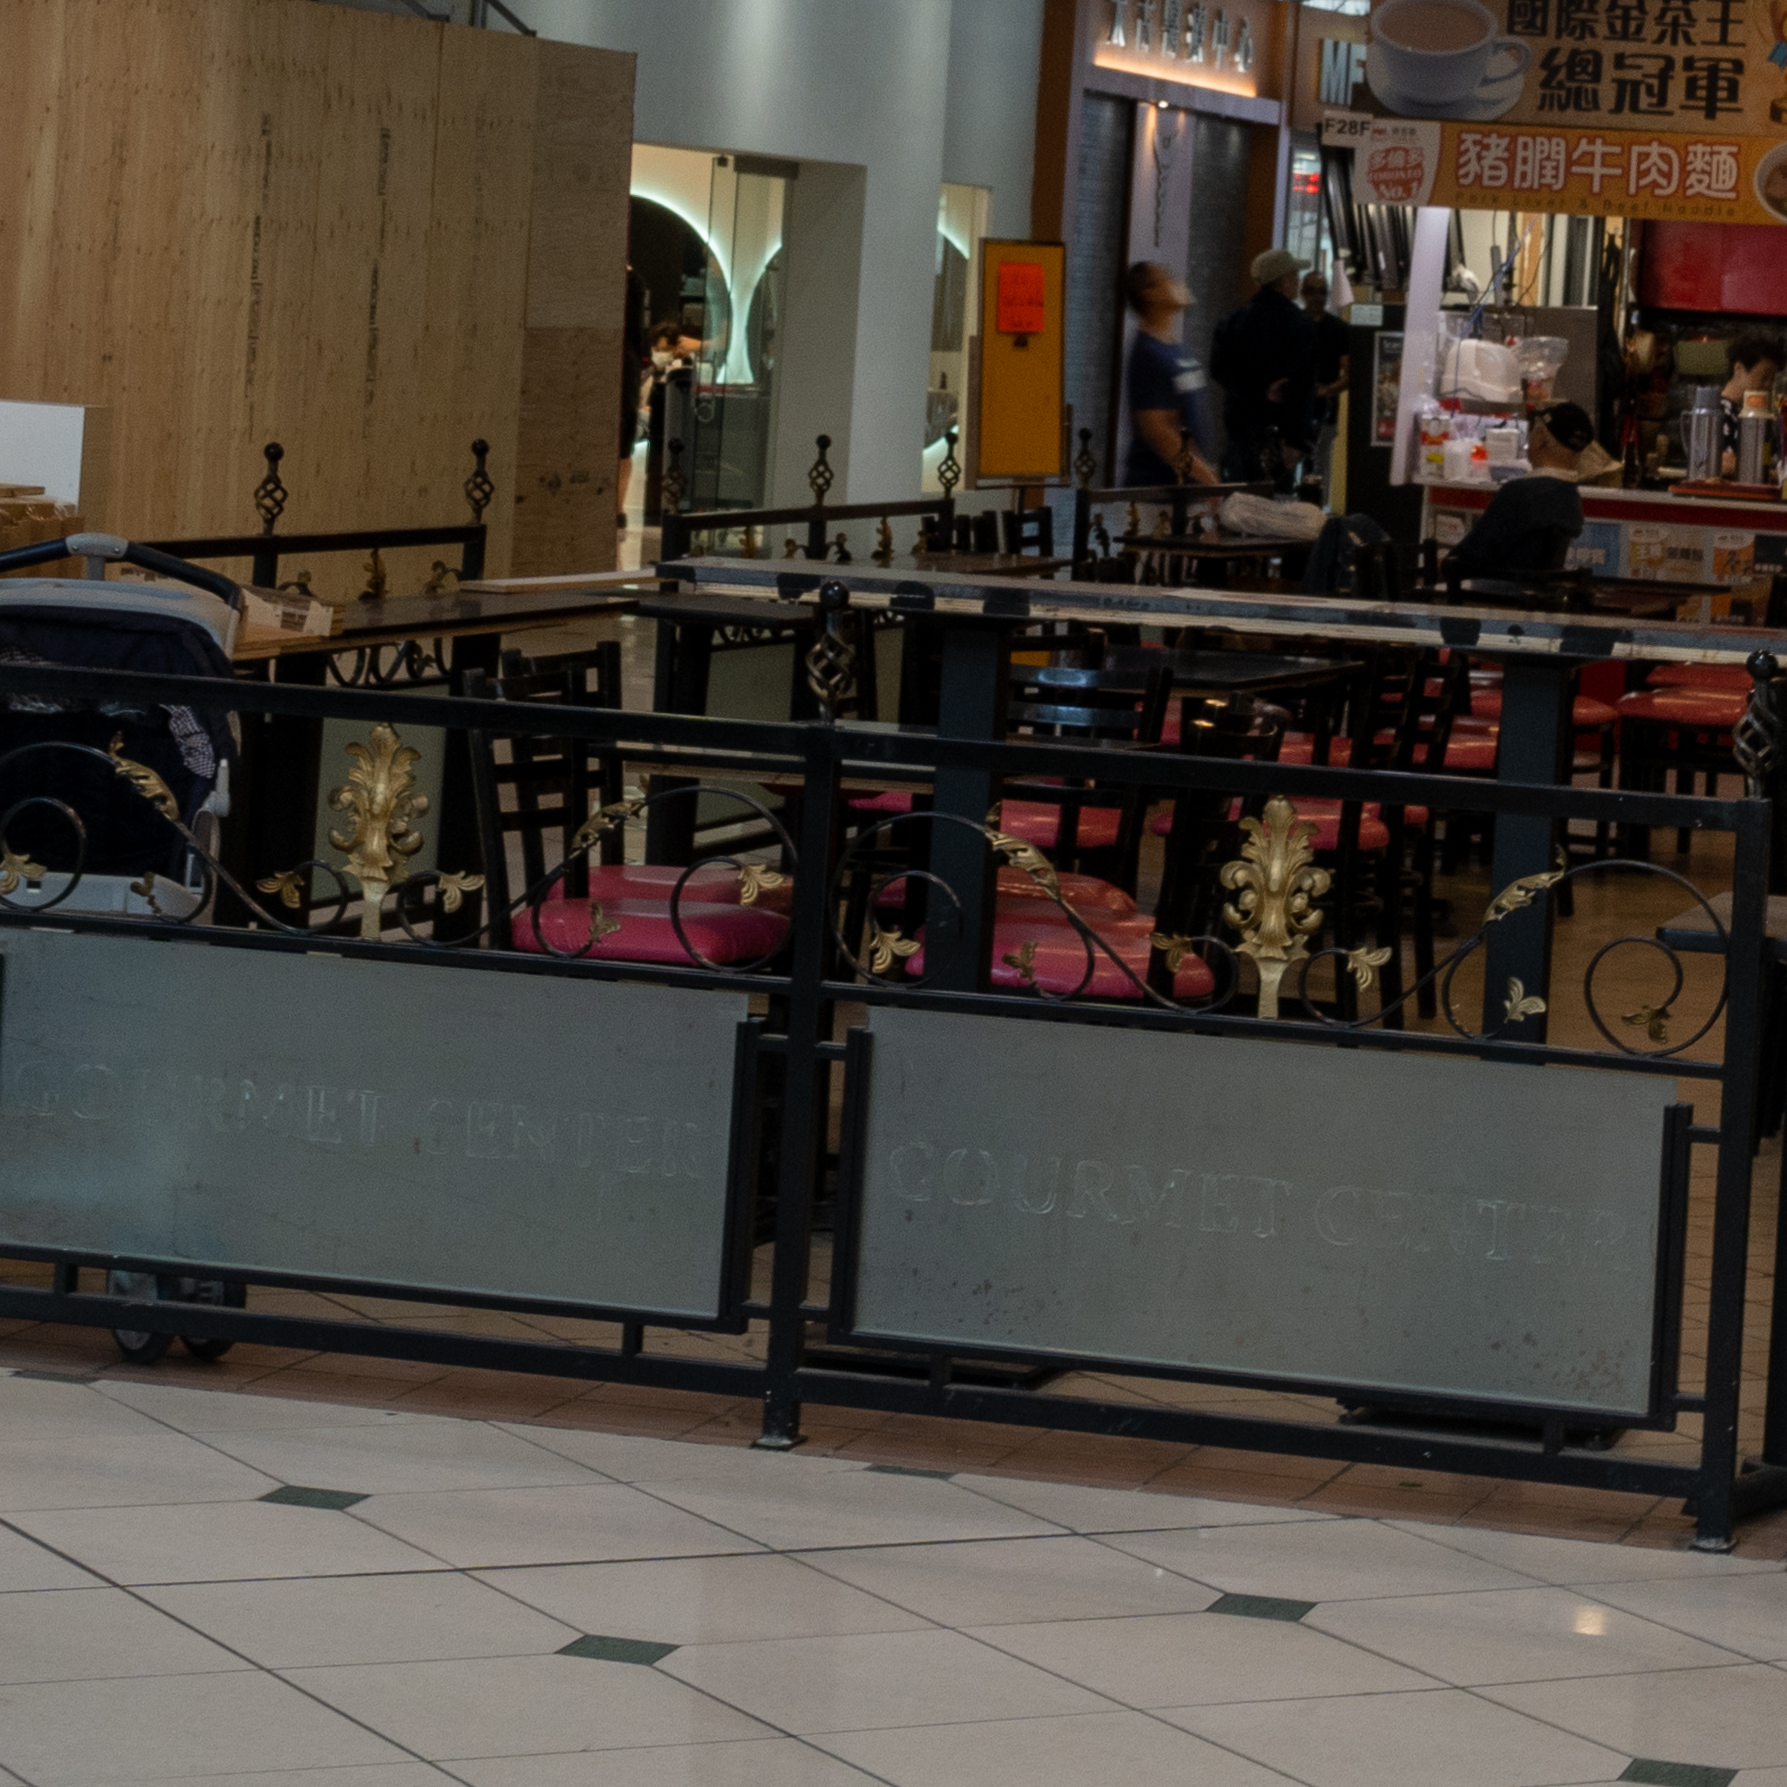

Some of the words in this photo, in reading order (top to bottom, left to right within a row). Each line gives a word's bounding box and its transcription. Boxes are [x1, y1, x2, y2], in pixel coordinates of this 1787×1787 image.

[1537, 45, 1747, 121] 總冠軍
[1324, 117, 1373, 137] F28F
[886, 1138, 1296, 1240] GOURMET
